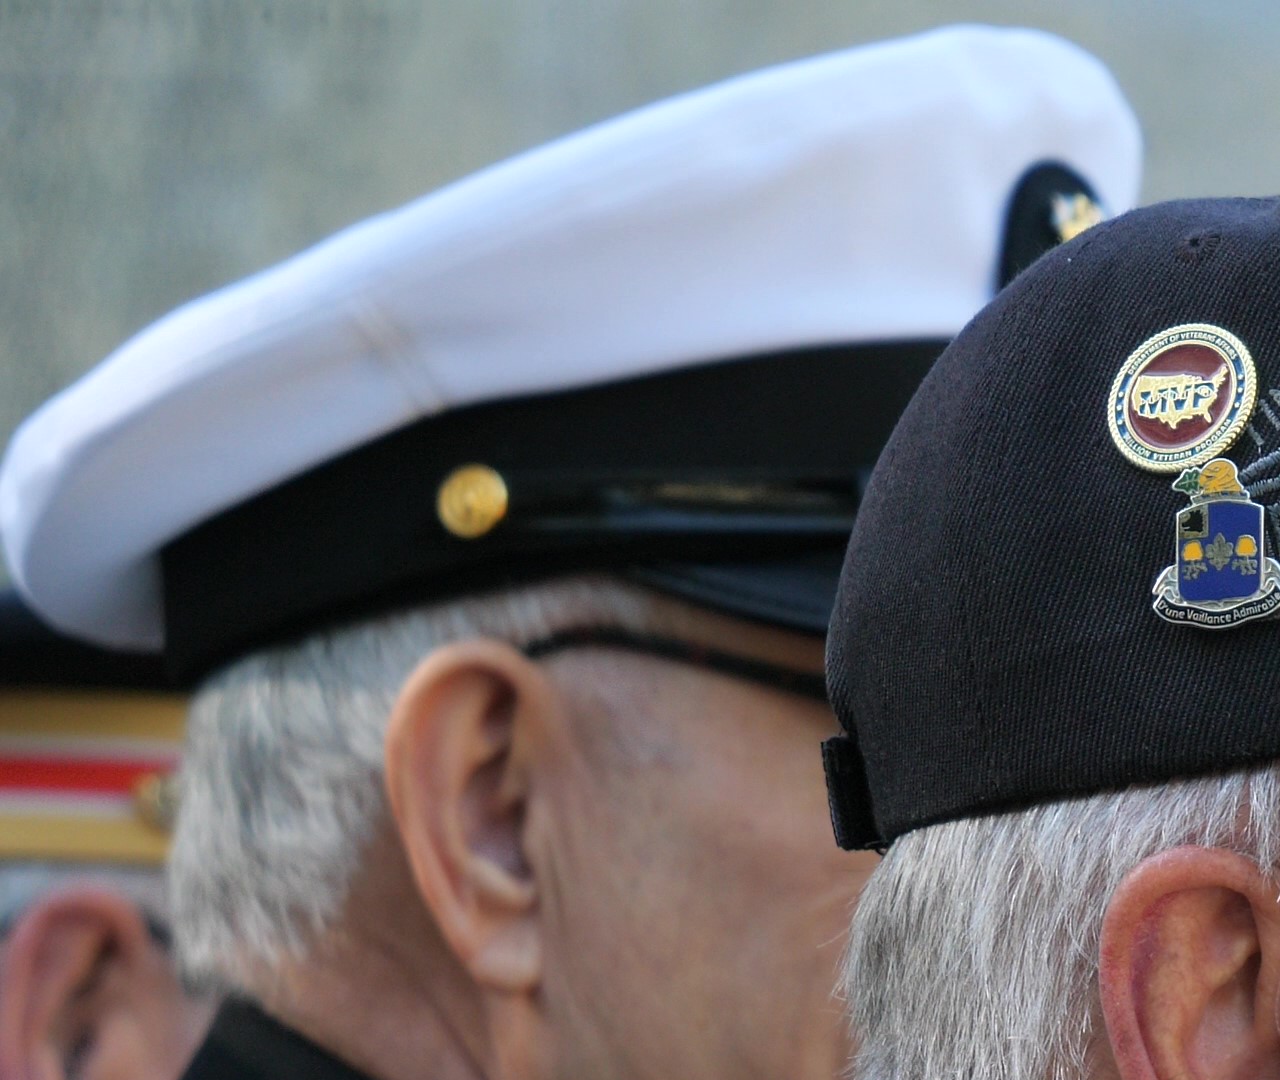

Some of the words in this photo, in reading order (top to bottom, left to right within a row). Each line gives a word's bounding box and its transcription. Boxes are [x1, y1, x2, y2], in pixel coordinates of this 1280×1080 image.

[1127, 338, 1168, 375] DEPARTMENT
[1169, 334, 1181, 343] OF
[1180, 331, 1216, 342] VETERANS
[1215, 336, 1238, 360] AFFAIRS
[1140, 383, 1215, 414] MVP
[1152, 450, 1192, 461] VETERAN
[1195, 418, 1232, 453] PROGRAM
